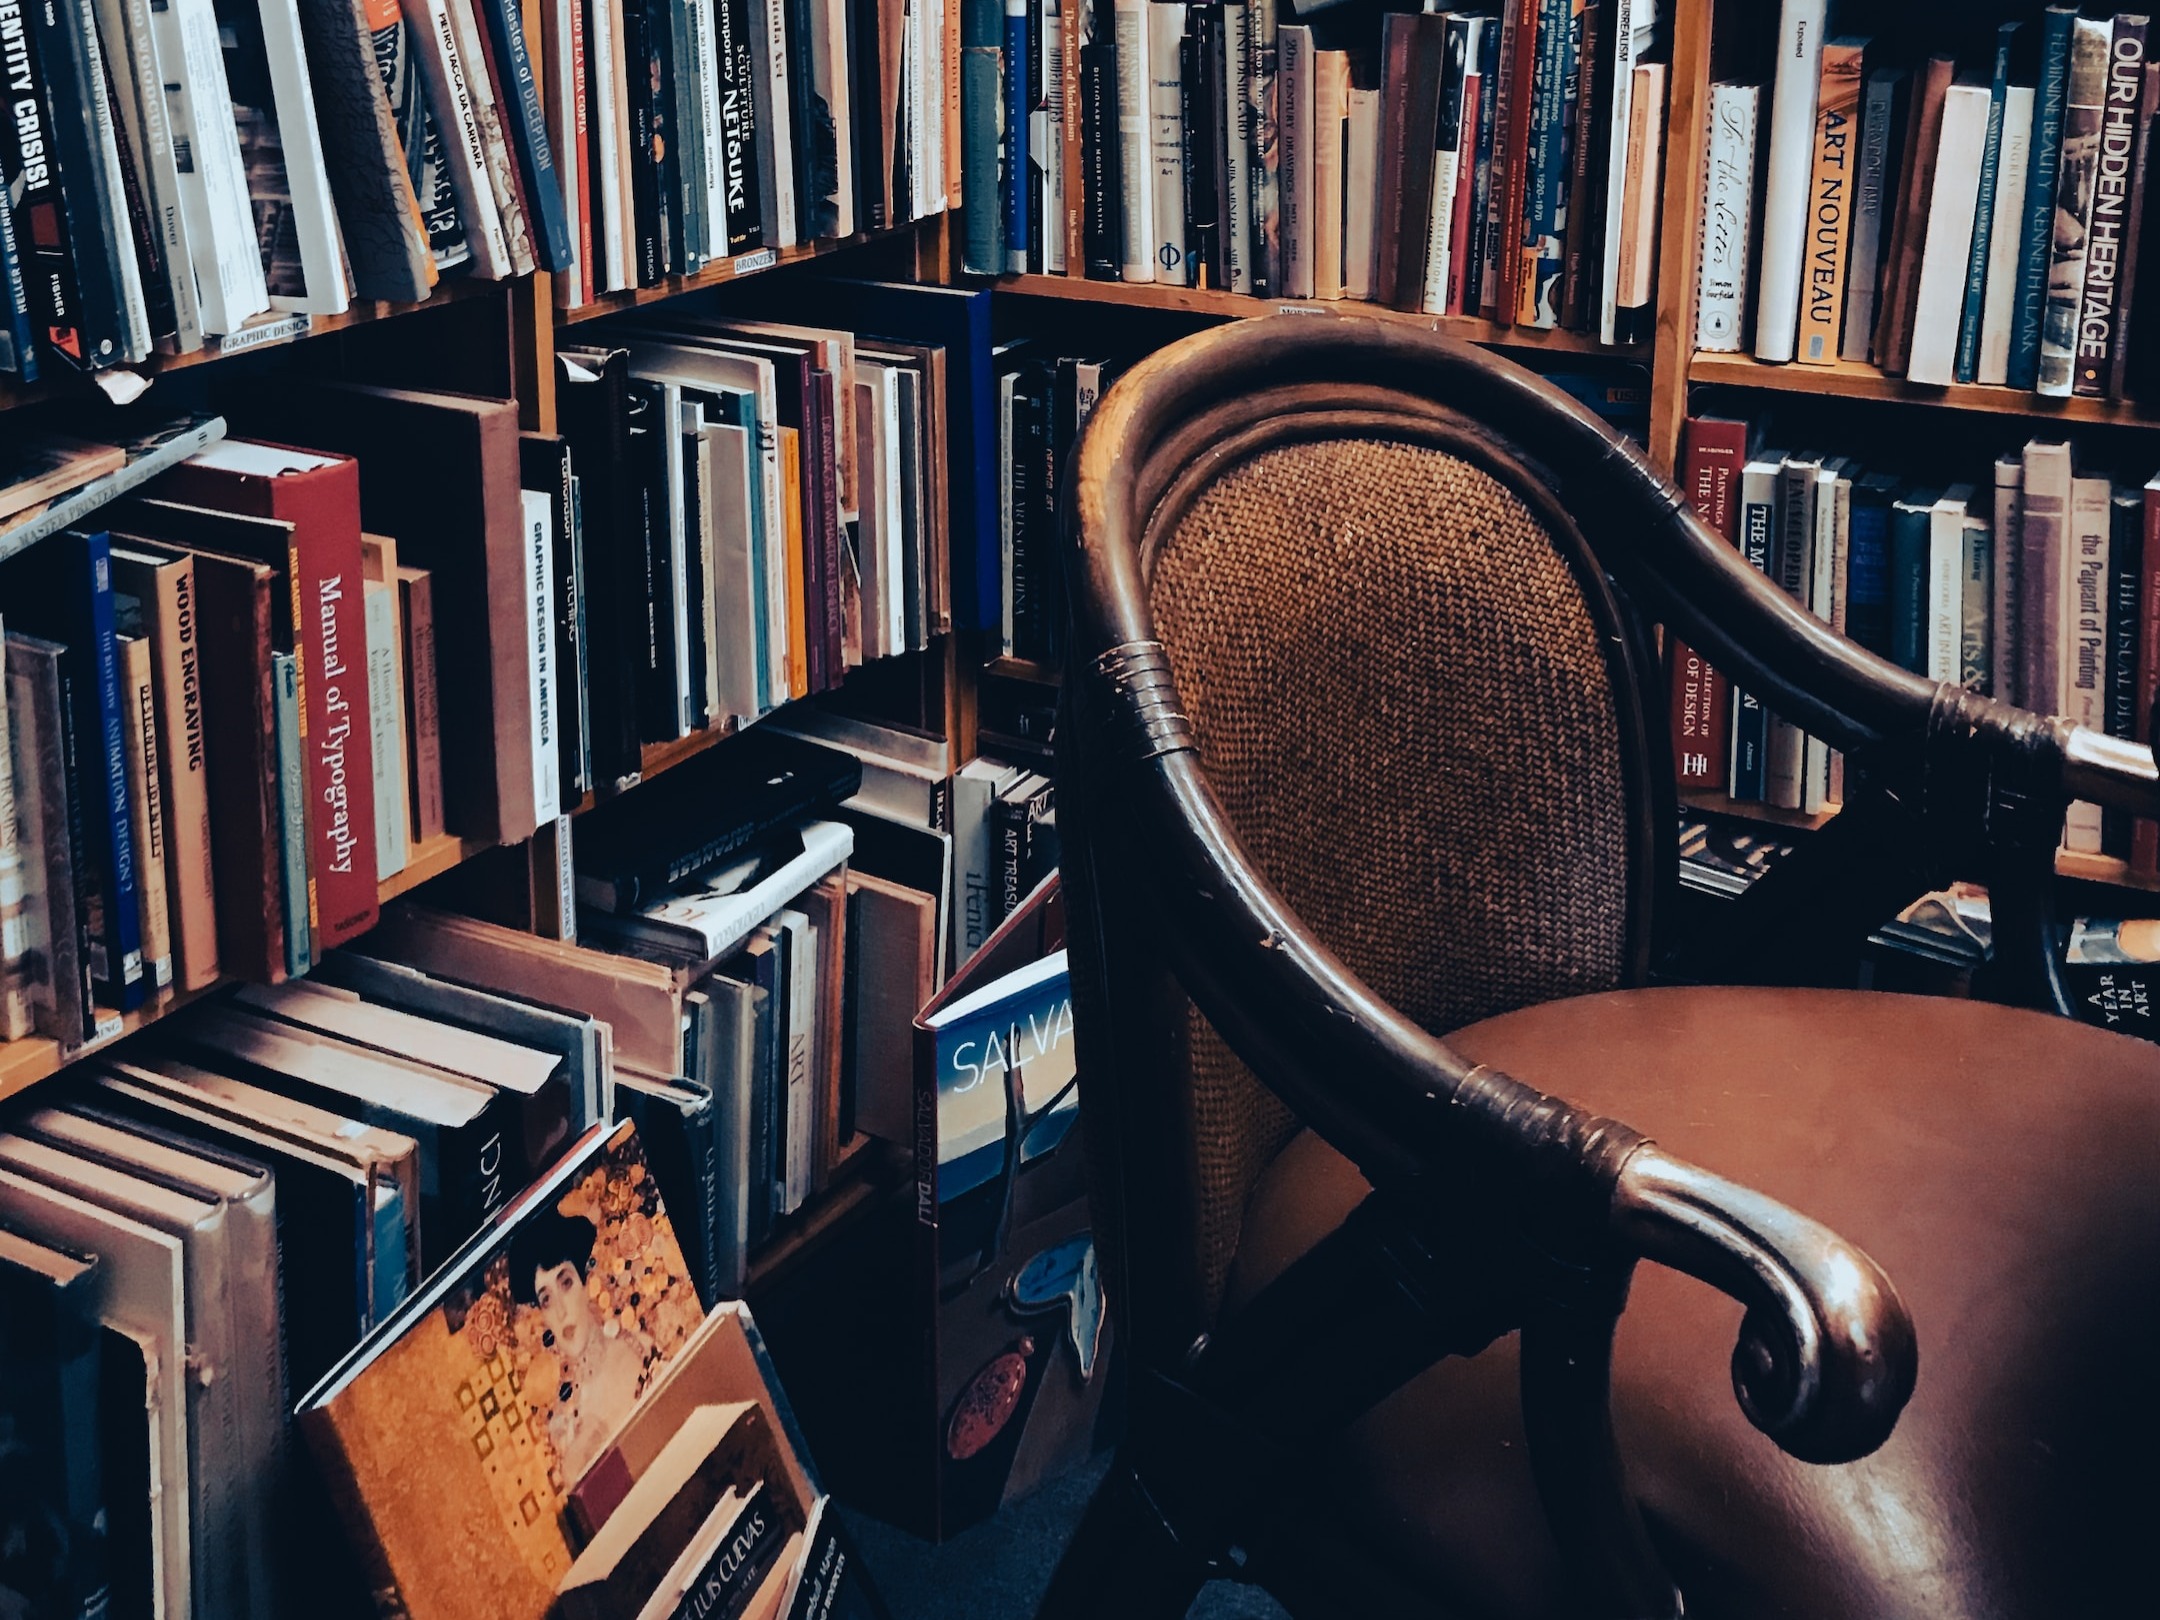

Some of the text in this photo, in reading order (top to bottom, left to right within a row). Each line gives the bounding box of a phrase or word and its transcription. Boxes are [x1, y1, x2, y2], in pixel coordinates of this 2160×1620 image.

[1544, 59, 1553, 71] en
[1545, 19, 1558, 56] artistas
[1795, 21, 1808, 58] Exposed
[137, 33, 167, 155] WOODCUTS
[437, 12, 484, 169] PIETRO TACCA DA CARRARA
[503, 0, 553, 172] Masters of DECEPTION
[574, 35, 588, 135] E LA SUA COPIA
[737, 44, 752, 142] SCULPTURE
[951, 29, 959, 112] BEARDSLEY
[1064, 8, 1078, 141] The Advent of Modernism
[1092, 67, 1101, 128] DICTIONARY
[1543, 74, 1553, 89] los
[2107, 36, 2144, 102] OUR
[1237, 60, 1249, 141] DISREGARD
[1285, 77, 1297, 129] CENTURY
[1539, 92, 1552, 131] Estados
[1577, 31, 1599, 177] The Advent of Modernism
[12, 98, 50, 190] CRISIS!
[722, 89, 746, 215] NETSUKE
[1094, 132, 1102, 143] OF
[1981, 100, 2002, 167] PENNSYLVANIA
[2007, 135, 2023, 189] INGRES
[2094, 105, 2135, 215] HIDDEN
[1285, 135, 1297, 193] DRAWINGS
[1439, 179, 1450, 199] ART
[1441, 156, 1452, 177] THE
[1712, 101, 1746, 272] To the Letter
[1979, 168, 1994, 202] DUTCH
[2021, 32, 2068, 354] FEMININE BEAUTY KENNETH CLARK
[1096, 191, 1104, 236] PAINTING
[1438, 200, 1449, 215] OF
[1534, 172, 1546, 221] 1920-1970
[1811, 110, 1848, 324] ART NOUVEAU
[165, 205, 178, 247] Dover
[1432, 215, 1447, 285] CELEBRATION
[1974, 203, 1991, 250] AMERICAN
[645, 237, 656, 280] HYPERION
[735, 252, 774, 271] BRONZES
[1969, 277, 1982, 296] ART
[17, 268, 28, 314] HELLER
[50, 273, 65, 317] FISHER
[2078, 219, 2123, 360] HERITAGE
[223, 332, 270, 350] GRAPHIC
[820, 414, 833, 487] DRAWINGS
[1014, 463, 1027, 491] THE
[821, 489, 835, 506] BY
[1697, 465, 1713, 499] THE
[1714, 466, 1730, 525] PAINTINGS
[18, 482, 120, 546] MASTER PRINTER
[824, 508, 837, 577] WHARTON
[1014, 500, 1027, 536] ARTS
[1749, 505, 1768, 544] THE
[289, 547, 302, 632] PAUL GAUGUIN
[565, 575, 577, 643] ETCHING
[1014, 563, 1026, 616] CHINA
[2074, 535, 2104, 690] the Pageant of Painting
[534, 521, 550, 747] GRAPHIC DESIGN IN AMERICA
[1938, 613, 1951, 636] ART
[1961, 609, 1989, 688] Arts &
[2115, 571, 2137, 690] THE VISUAL
[174, 573, 203, 772] WOOD ENGRAVING
[294, 642, 306, 666] INGO
[318, 573, 357, 874] Manual of Typography
[1682, 656, 1700, 738] OF DESIGN
[100, 630, 132, 880] THE BEST NEW ANIMATION DESIGN
[1699, 722, 1710, 738] OF
[139, 684, 164, 859] DESIGNING IDENTITY
[1004, 827, 1018, 856] ART
[307, 877, 320, 928] TASCHEN
[561, 870, 573, 935] ART BOOKS
[2087, 992, 2103, 1006] A
[2100, 973, 2120, 1023] YEAR
[2118, 989, 2134, 1010] IN
[2131, 980, 2151, 1018] ART
[790, 1032, 805, 1087] ART
[951, 997, 1074, 1094] SALVA
[916, 1089, 935, 1182] SALVADOR
[718, 1510, 768, 1584] CUEVAS
